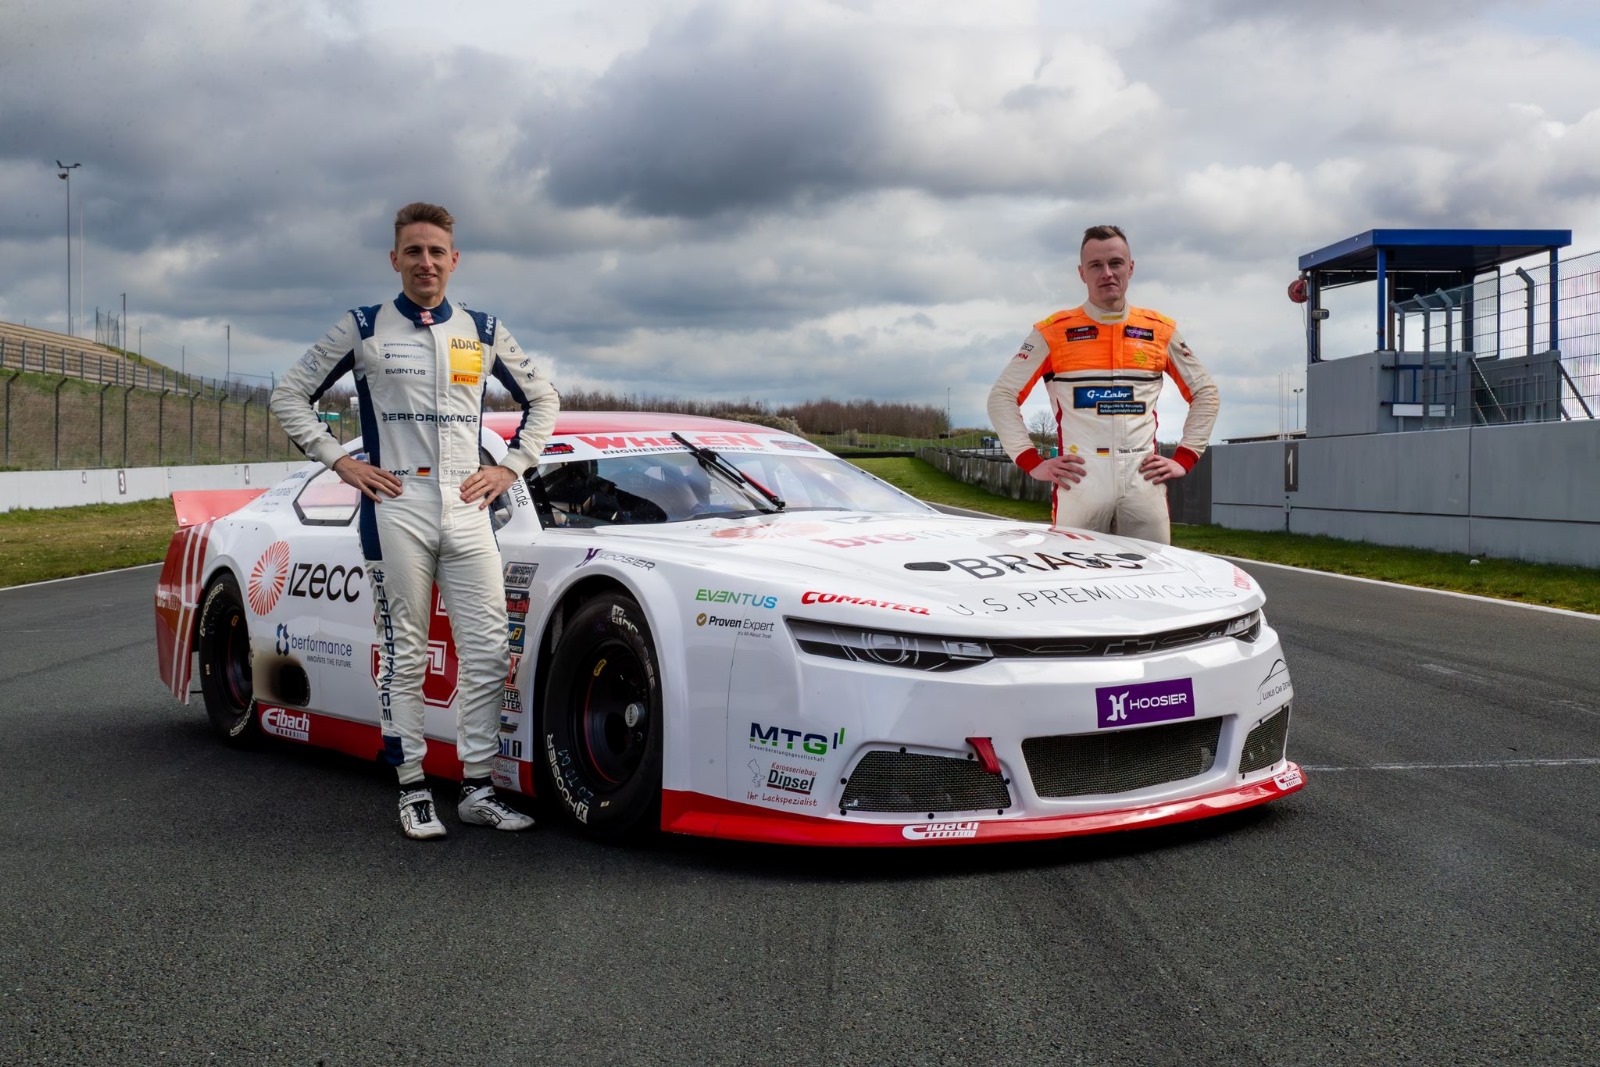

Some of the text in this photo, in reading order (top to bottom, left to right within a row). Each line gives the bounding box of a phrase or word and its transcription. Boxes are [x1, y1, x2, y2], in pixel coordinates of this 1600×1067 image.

[451, 338, 480, 351] ADAC
[385, 368, 426, 376] EVENTUS
[1287, 449, 1293, 485] 1
[119, 473, 125, 492] 3
[596, 553, 656, 571] HOOSIER
[947, 551, 1144, 579] BRASS
[695, 588, 777, 609] EVENTUS
[801, 591, 930, 615] COMATEQ
[708, 615, 775, 632] Proven Expert
[291, 634, 352, 657] berformance
[1129, 693, 1187, 710] HOOSIER
[262, 708, 310, 738] Eibach
[749, 722, 828, 755] MTG
[748, 744, 826, 763] Steuerberatungsgesellschaft
[546, 733, 579, 813] HOOSIER
[771, 762, 818, 777] Karosseriebau
[767, 769, 816, 791] Dipsel
[747, 791, 818, 807] Ihr Lackspezialist
